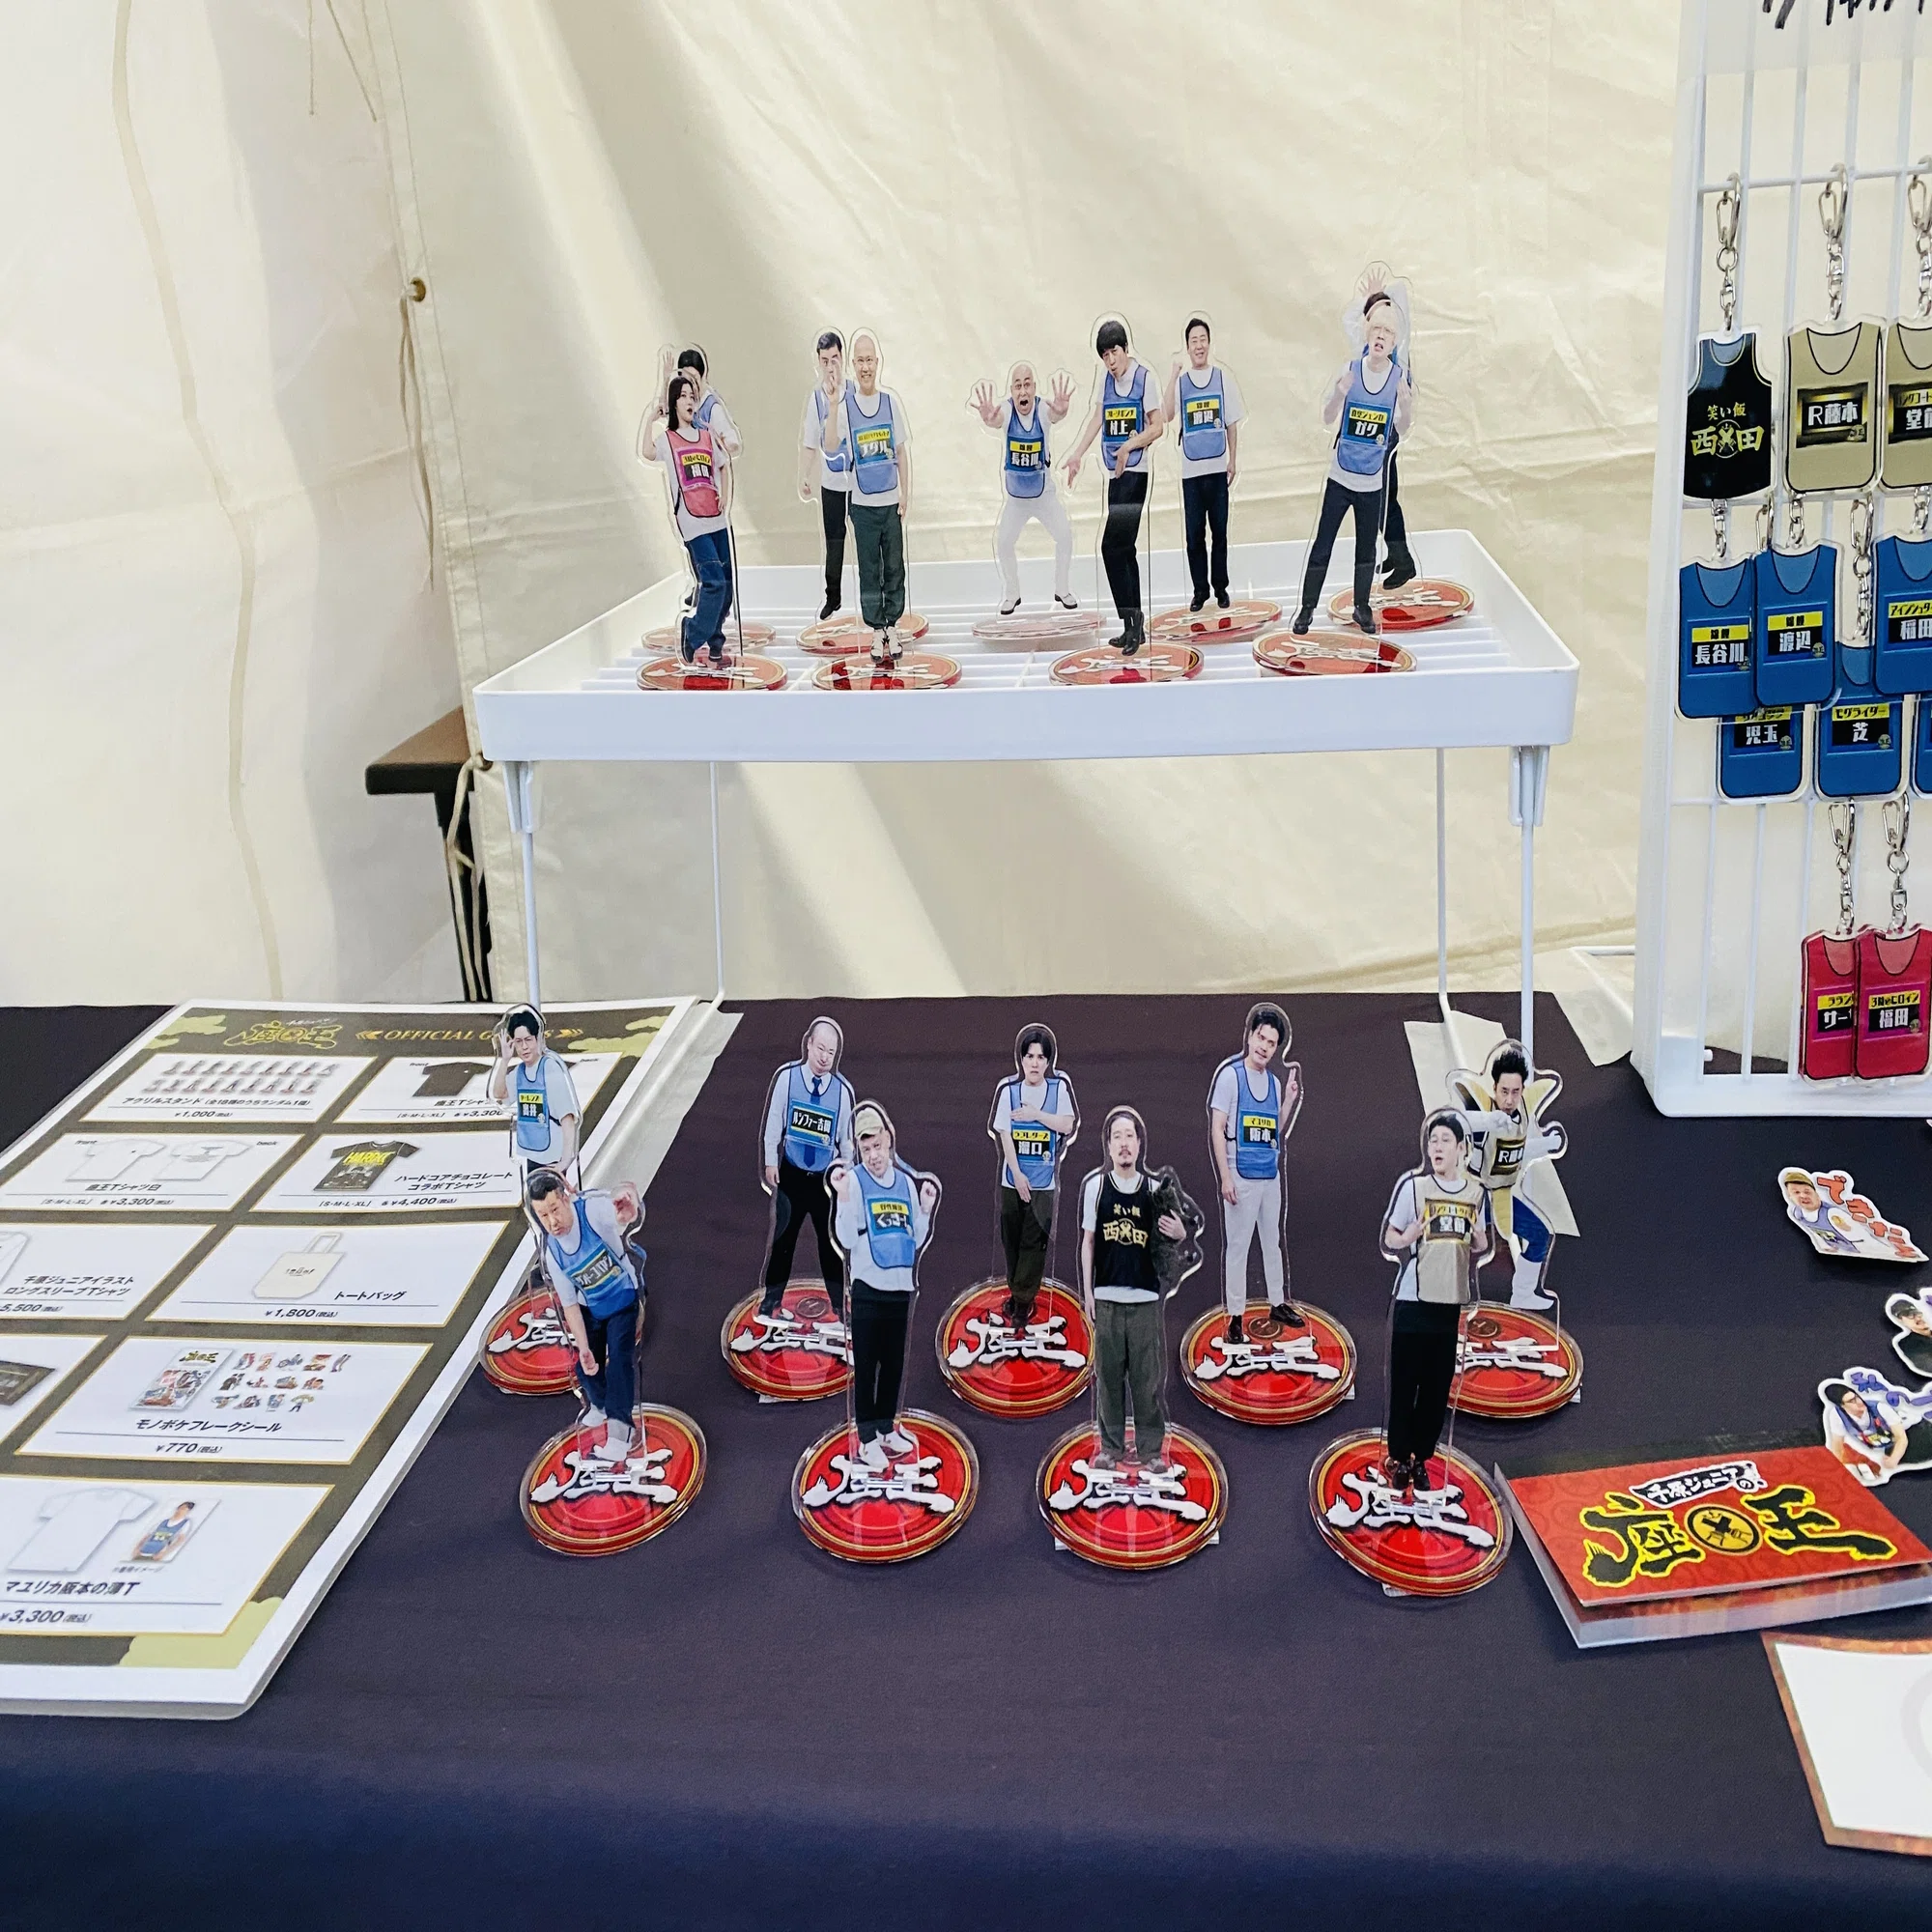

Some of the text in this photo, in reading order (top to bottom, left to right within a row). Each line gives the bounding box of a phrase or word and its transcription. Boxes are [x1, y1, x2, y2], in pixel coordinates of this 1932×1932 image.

[1707, 402, 1747, 421] 笑い飯
[1807, 402, 1859, 426] R藤本
[1110, 419, 1128, 436] 村上
[1354, 420, 1378, 437] ガク
[1690, 425, 1765, 456] 西田
[1011, 451, 1038, 467] 長谷川
[1890, 602, 1932, 616] アインシュタ
[1779, 630, 1811, 652] 渡辺
[1695, 643, 1745, 665] 長谷川
[1835, 705, 1886, 719] モグライダー
[1746, 724, 1778, 745] 児玉
[1853, 722, 1869, 742] 芝
[1828, 995, 1854, 1007] ララン
[1879, 1008, 1909, 1029] 福田
[384, 1029, 475, 1040] OFFICIAL
[394, 1172, 513, 1182] ハードコアチョコレート
[408, 1181, 486, 1191] コラボTシャツ
[1114, 1203, 1141, 1217] 笑い飯
[1102, 1220, 1149, 1248] 西田
[24, 1275, 134, 1285] 千原ジュニアイラスト
[3, 1287, 131, 1296] ロングスリーブTシャツ
[334, 1291, 408, 1301] トートバッグ
[947, 1314, 1086, 1368] 座王
[1193, 1334, 1341, 1379] 座王
[136, 1419, 282, 1433] モノボケフレークシール
[530, 1449, 677, 1504] 座王
[802, 1454, 955, 1513] 座王
[1048, 1459, 1207, 1520] 座王
[1325, 1466, 1496, 1547] 座王
[6, 1580, 141, 1595] マユリカ阪本の薄T
